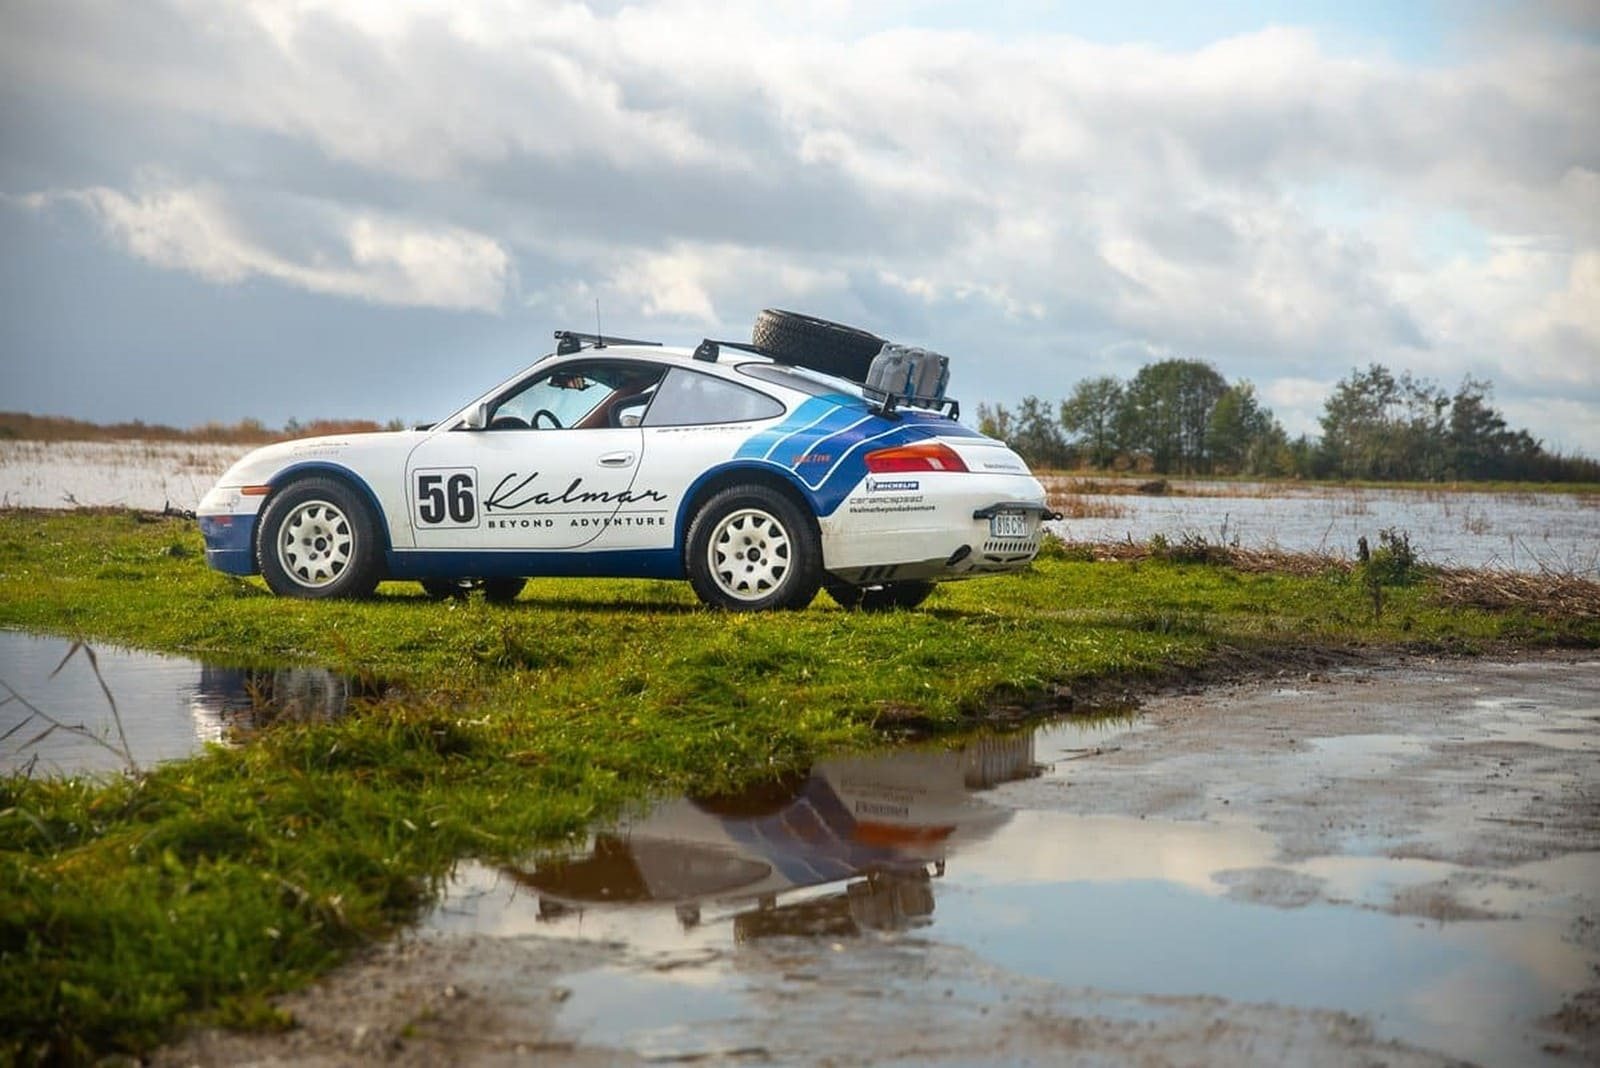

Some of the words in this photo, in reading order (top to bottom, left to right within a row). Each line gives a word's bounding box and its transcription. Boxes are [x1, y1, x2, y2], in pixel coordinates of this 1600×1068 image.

[418, 474, 474, 524] 56
[484, 472, 668, 512] Kalmar
[488, 519, 554, 529] BEYOND
[570, 517, 666, 527] ADVENTURE
